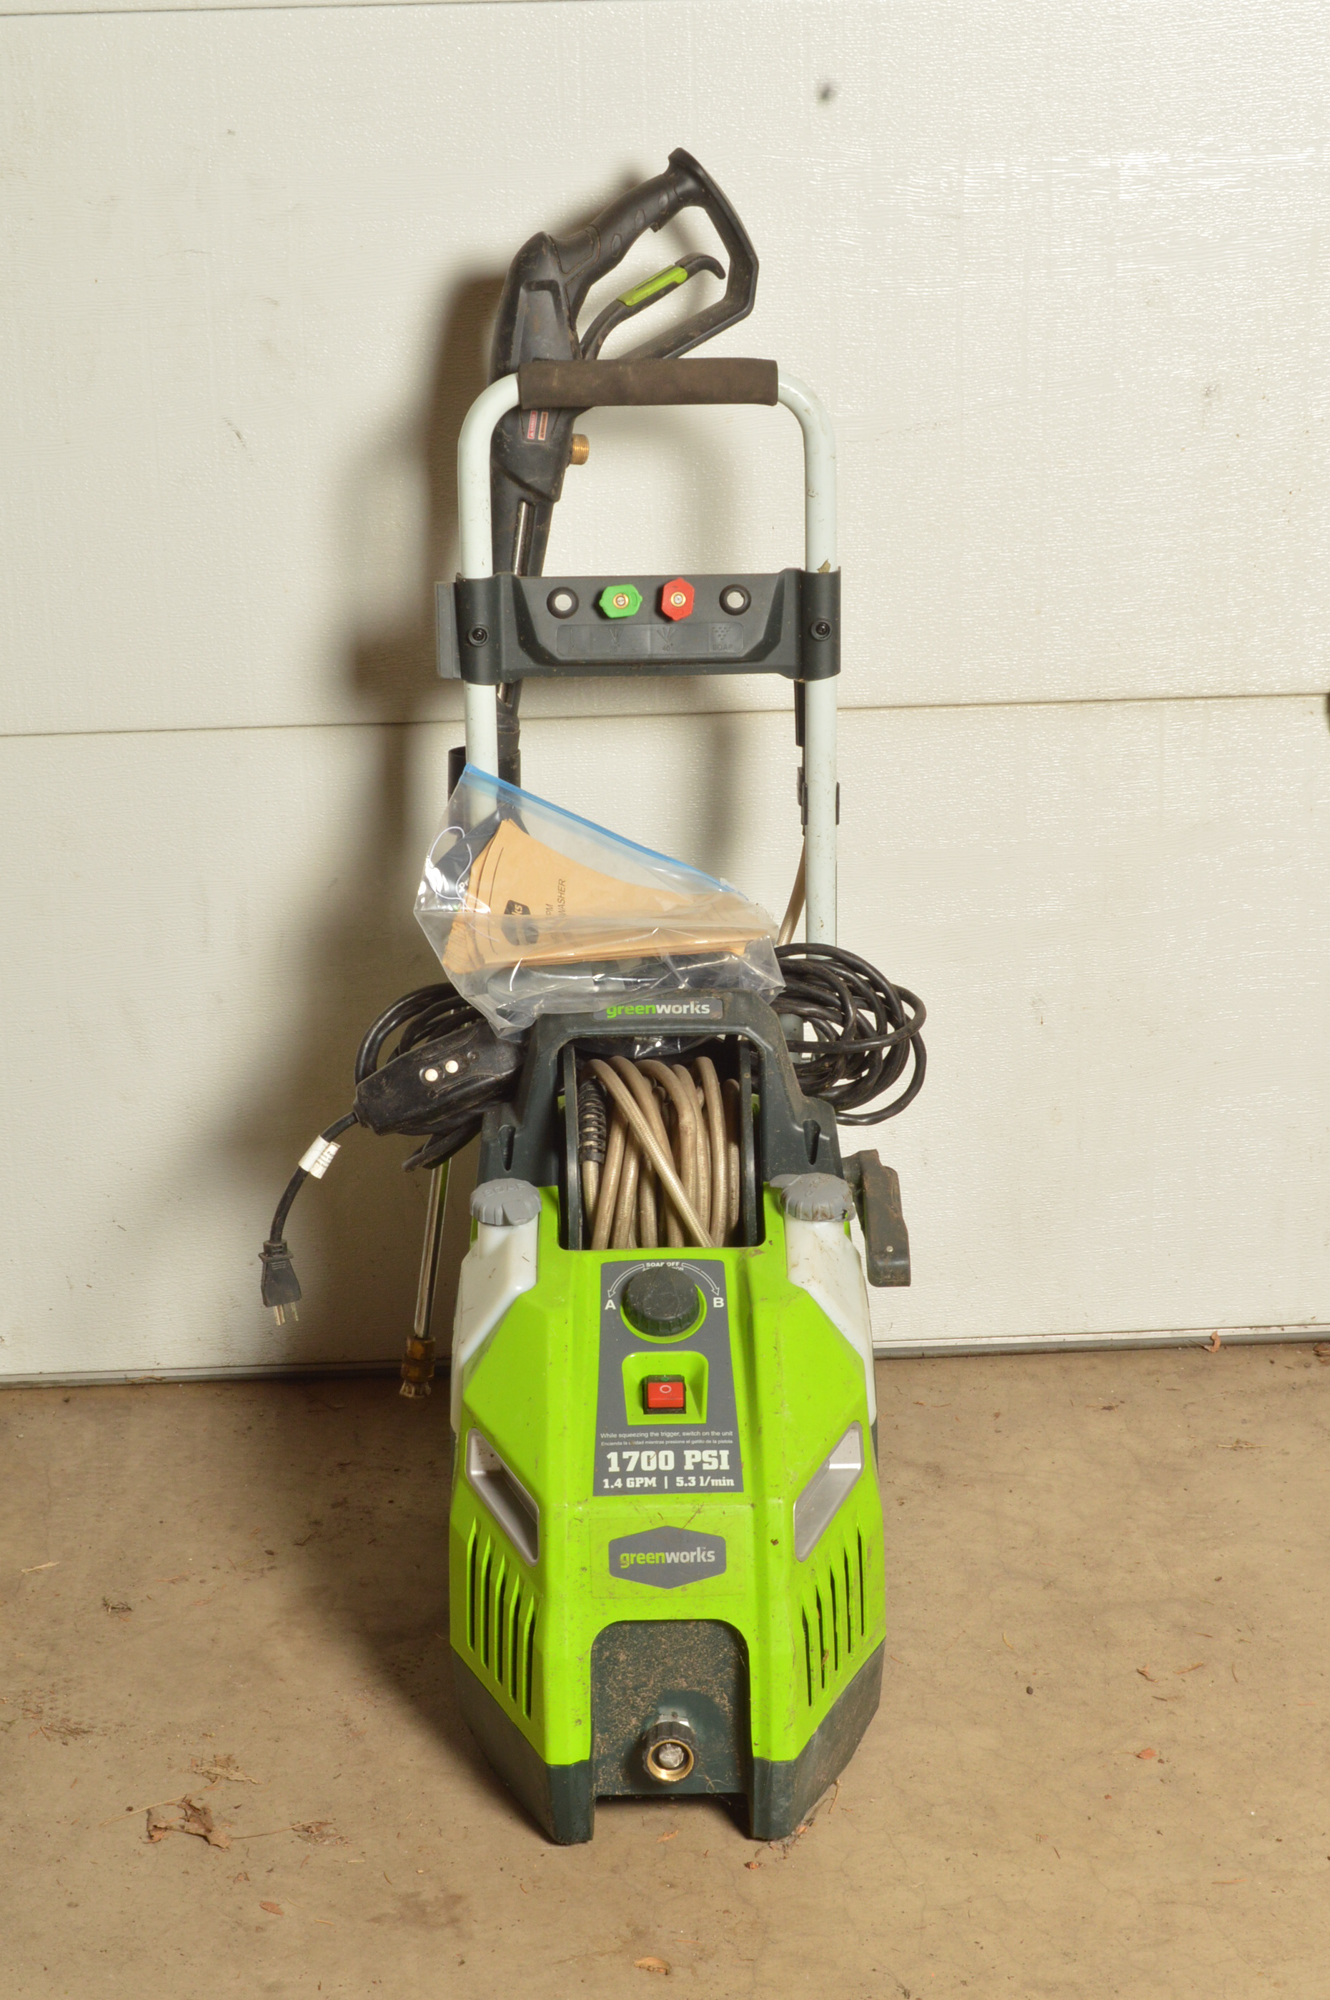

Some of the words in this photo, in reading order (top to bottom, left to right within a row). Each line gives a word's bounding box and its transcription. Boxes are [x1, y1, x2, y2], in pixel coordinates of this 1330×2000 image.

[606, 1001, 711, 1019] greenworks
[604, 1299, 617, 1310] A
[713, 1297, 725, 1308] B
[660, 1430, 681, 1439] trigger,
[606, 1450, 675, 1473] 1700
[683, 1449, 730, 1471] PSI
[603, 1478, 623, 1489] 1.4
[626, 1476, 657, 1488] GPM
[675, 1476, 696, 1487] 5.3
[699, 1476, 735, 1487] l/min
[619, 1546, 716, 1569] greenworks
